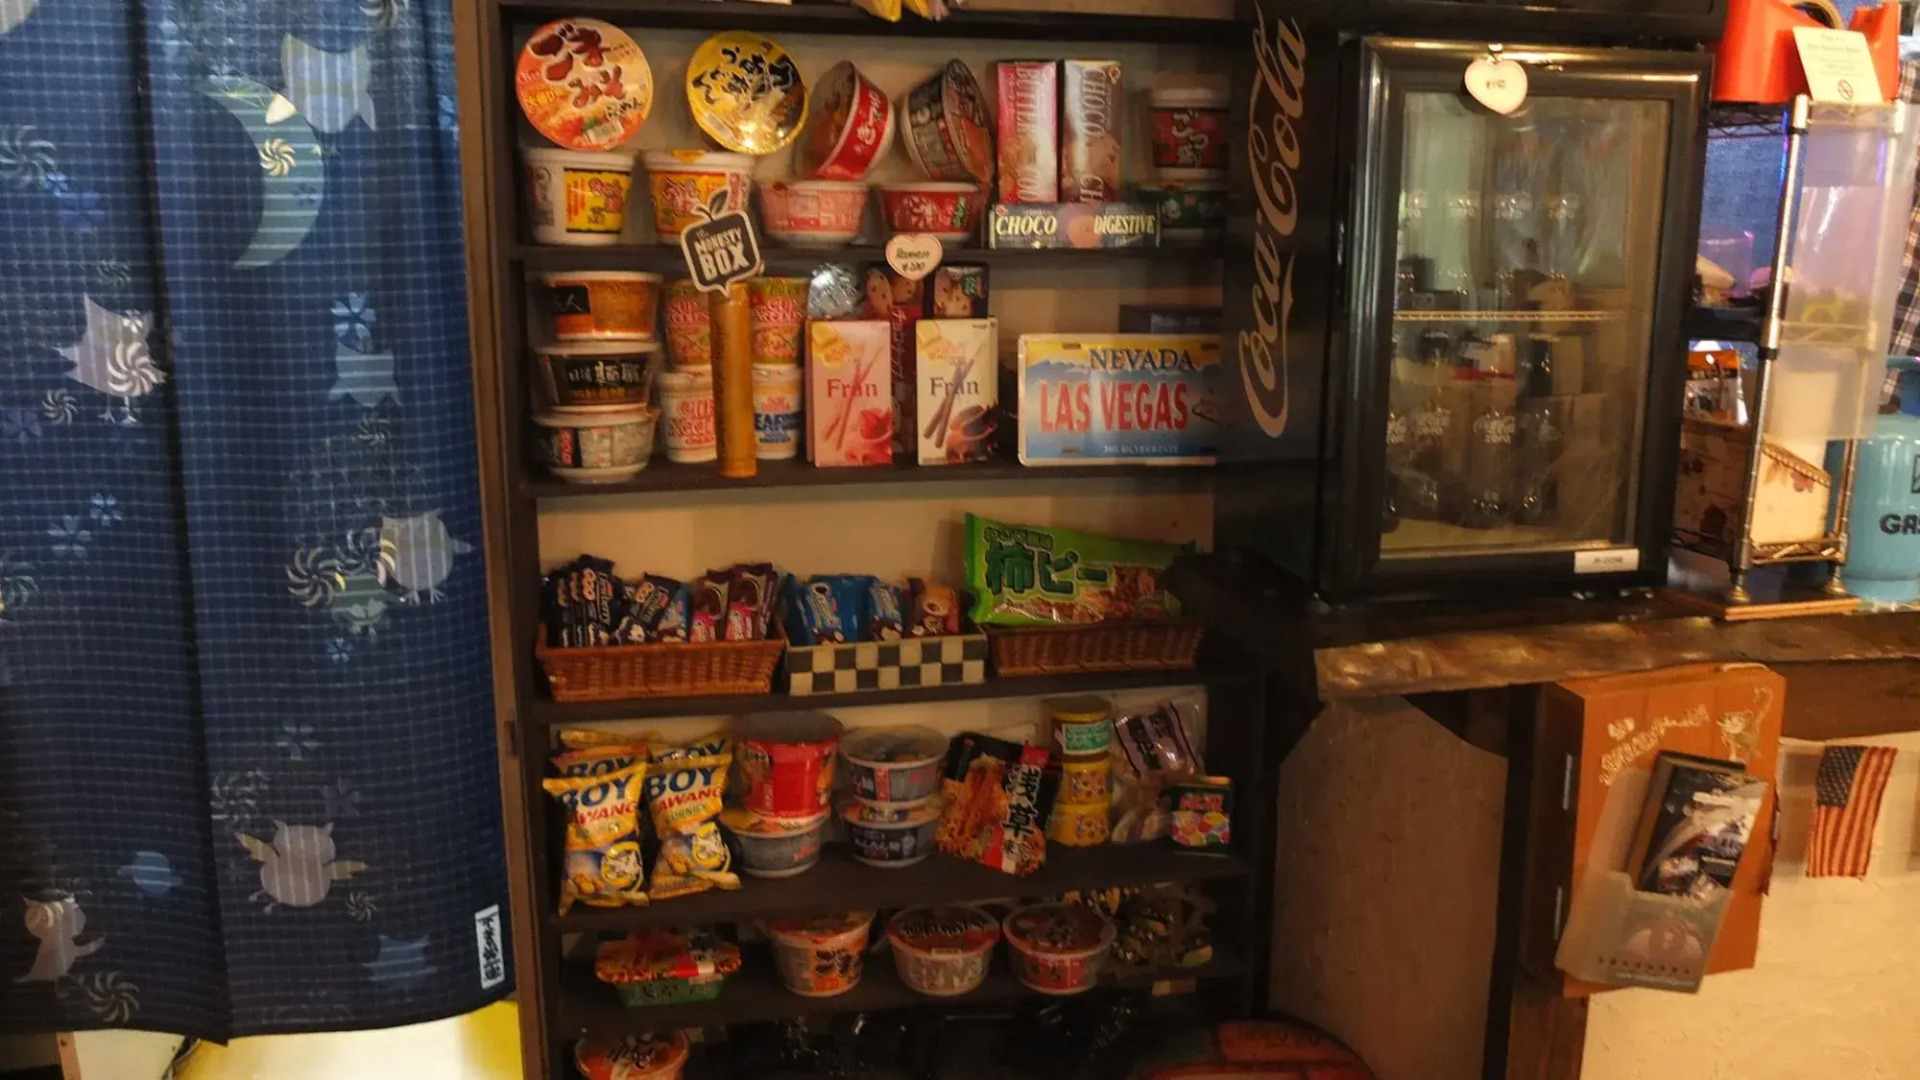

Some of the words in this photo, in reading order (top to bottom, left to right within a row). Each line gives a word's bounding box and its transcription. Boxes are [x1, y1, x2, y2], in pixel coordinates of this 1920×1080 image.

[1080, 68, 1107, 138] CHOCO
[1016, 165, 1041, 200] COO
[1079, 174, 1105, 203] CH
[995, 215, 1058, 235] CHOCO
[1094, 214, 1157, 234] DIGESTIVE
[1238, 2, 1306, 438] Coca-Cola
[700, 241, 750, 280] BOX
[1090, 349, 1197, 371] NEVADA
[827, 378, 878, 397] Fran
[930, 376, 979, 396] Fran
[1039, 381, 1091, 433] LAS
[1100, 381, 1190, 431] VEGAS
[1879, 513, 1920, 535] GA
[986, 541, 1107, 597] 柿ピー
[645, 766, 717, 802] BOY
